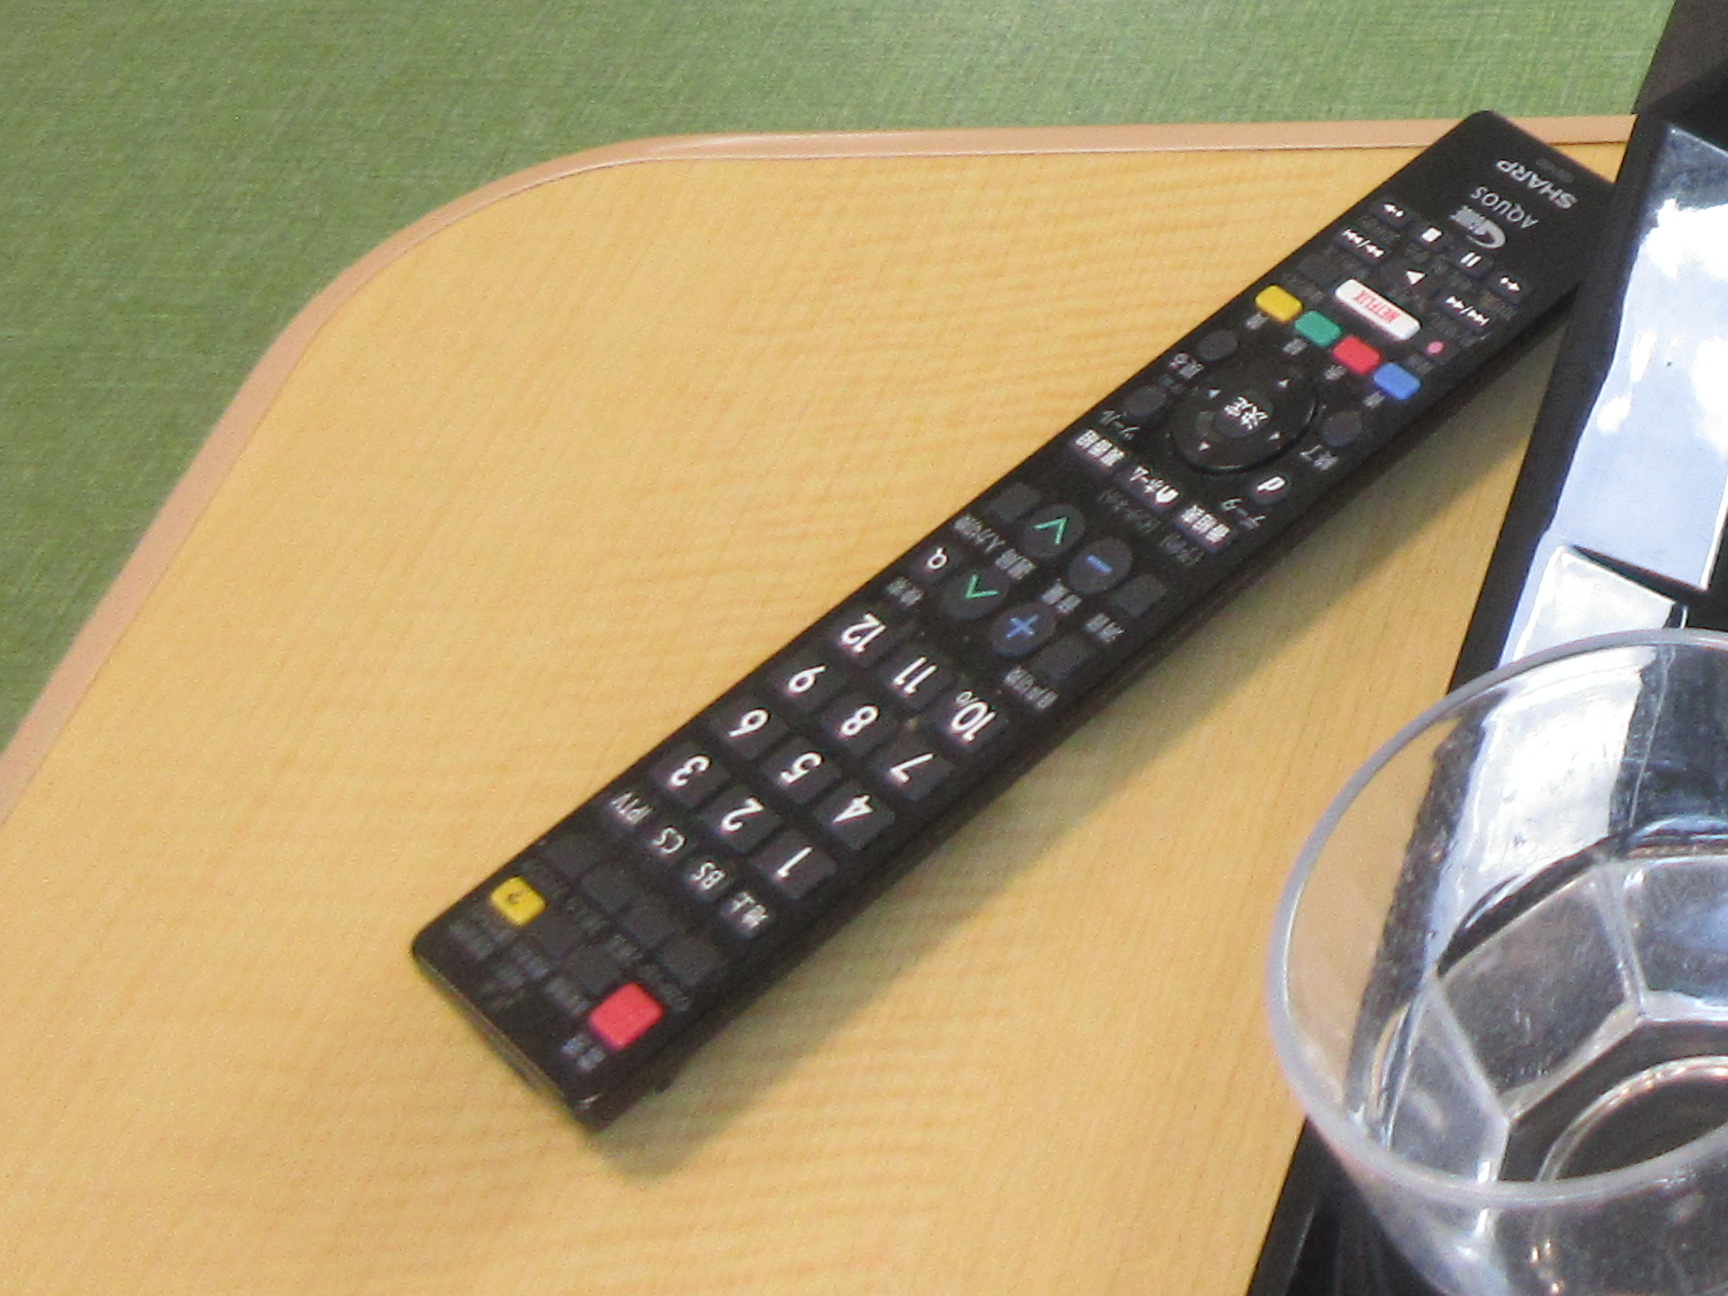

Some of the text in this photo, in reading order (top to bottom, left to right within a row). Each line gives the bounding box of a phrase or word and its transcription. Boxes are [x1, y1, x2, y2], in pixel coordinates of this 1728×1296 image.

[1495, 160, 1577, 209] SHARP
[1470, 186, 1539, 229] AQUOS
[1354, 292, 1401, 322] NETFLIX
[1224, 396, 1268, 430] 決定
[1181, 505, 1230, 543] 番組表
[840, 613, 886, 653] 12
[787, 666, 826, 694] 9
[892, 657, 937, 695] 11
[728, 709, 768, 738] 6
[839, 706, 878, 737] 8
[668, 756, 709, 788] 3
[779, 752, 822, 785] 5
[889, 753, 933, 783] 7
[610, 792, 650, 825] IPTV
[720, 798, 763, 832] 2
[833, 795, 872, 823] 4
[651, 827, 685, 855] CS
[691, 862, 725, 891] BS
[775, 847, 812, 879] 1
[731, 892, 768, 929] 地上
